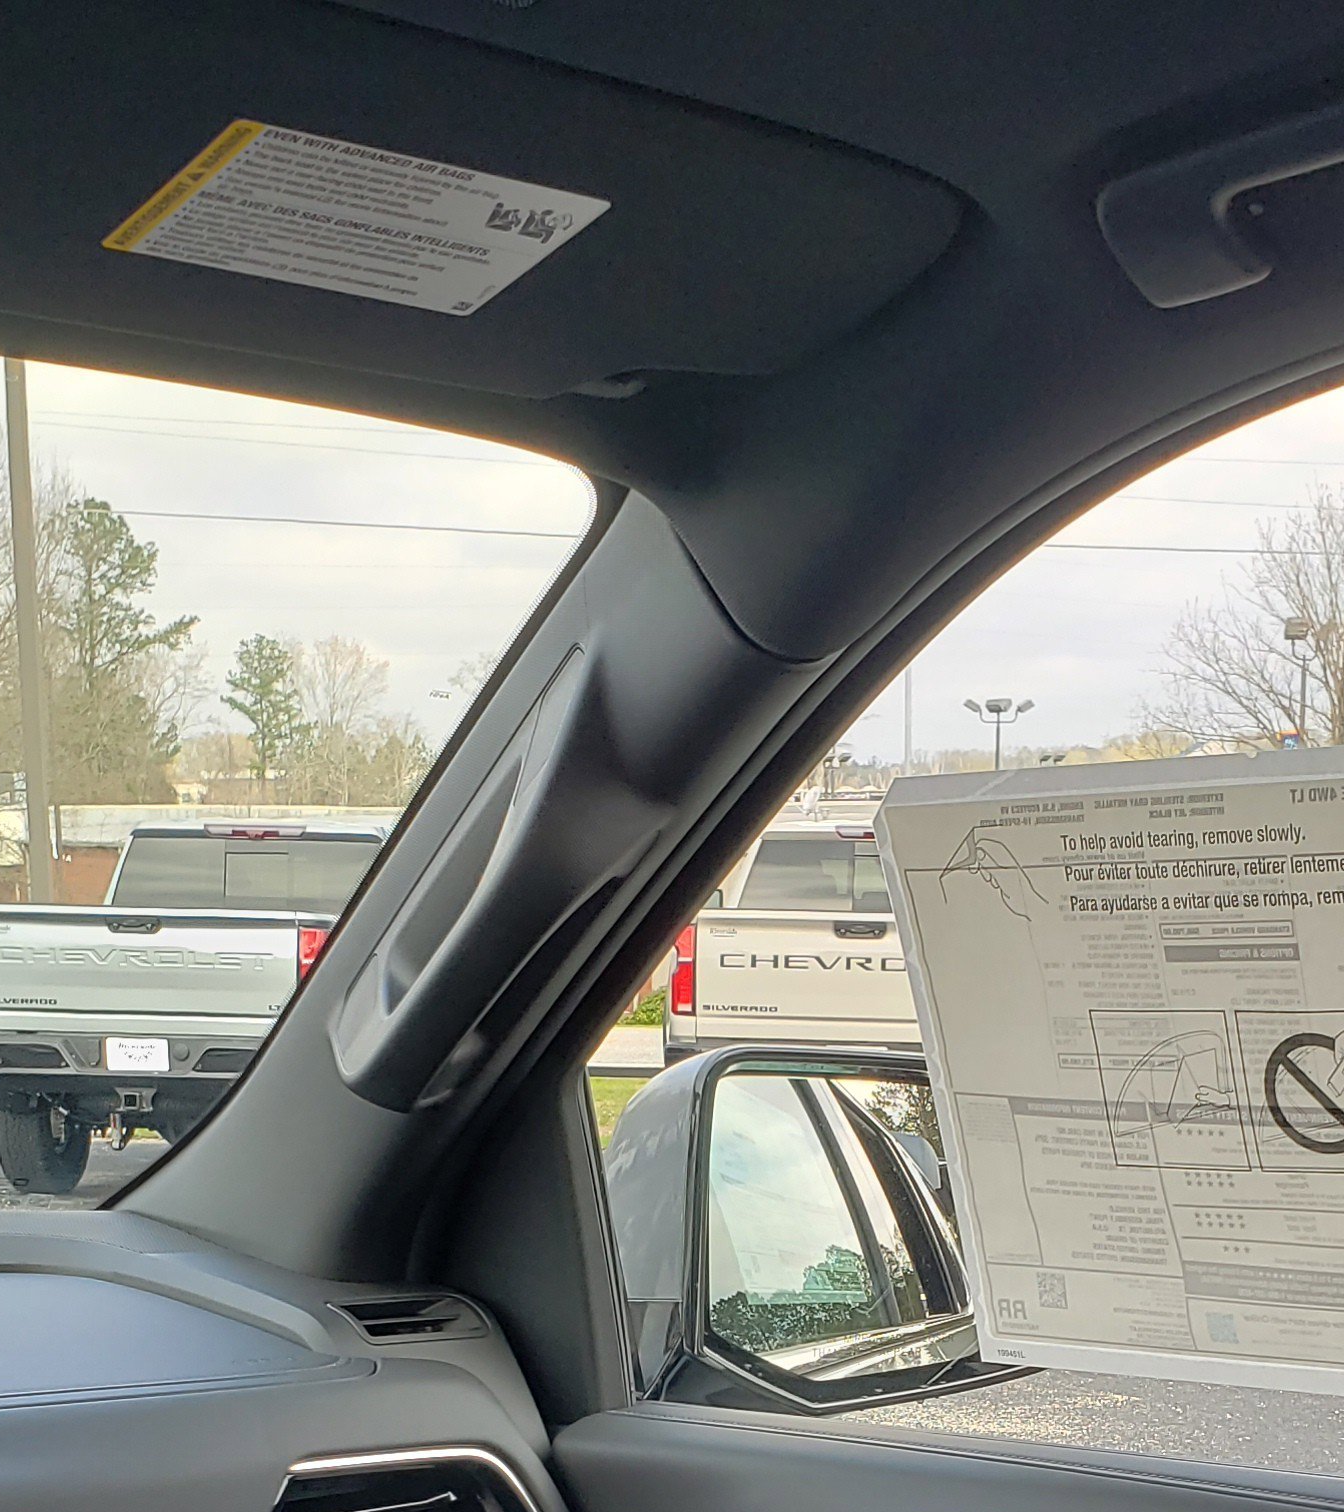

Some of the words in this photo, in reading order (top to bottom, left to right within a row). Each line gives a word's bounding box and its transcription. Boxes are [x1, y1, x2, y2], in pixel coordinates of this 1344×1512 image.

[263, 128, 299, 150] EVEN
[301, 136, 338, 157] WITH
[339, 143, 413, 172] ADVANCED
[414, 160, 436, 175] AIR
[437, 165, 477, 182] BAGS
[273, 203, 297, 217] DES
[1059, 834, 1077, 851] To
[1078, 832, 1107, 854] help
[1107, 830, 1144, 849] avoid
[1145, 827, 1199, 851] tearing,
[1200, 829, 1254, 845] remove
[1254, 822, 1306, 846] slowly.
[1063, 864, 1094, 882] Pour
[1095, 862, 1133, 880] éviter
[1133, 860, 1169, 879] toute
[1170, 857, 1240, 879] déchirure,
[1242, 856, 1287, 875] retirer
[1068, 894, 1098, 912] Para
[1098, 892, 1158, 914] ayudarse
[1159, 895, 1170, 909] a
[1171, 891, 1211, 909] evitar
[1212, 894, 1240, 911] que
[1241, 893, 1259, 907] se
[1261, 890, 1313, 910] rompa,
[719, 953, 907, 972] CHEVRO
[702, 1004, 778, 1013] SILVERADO
